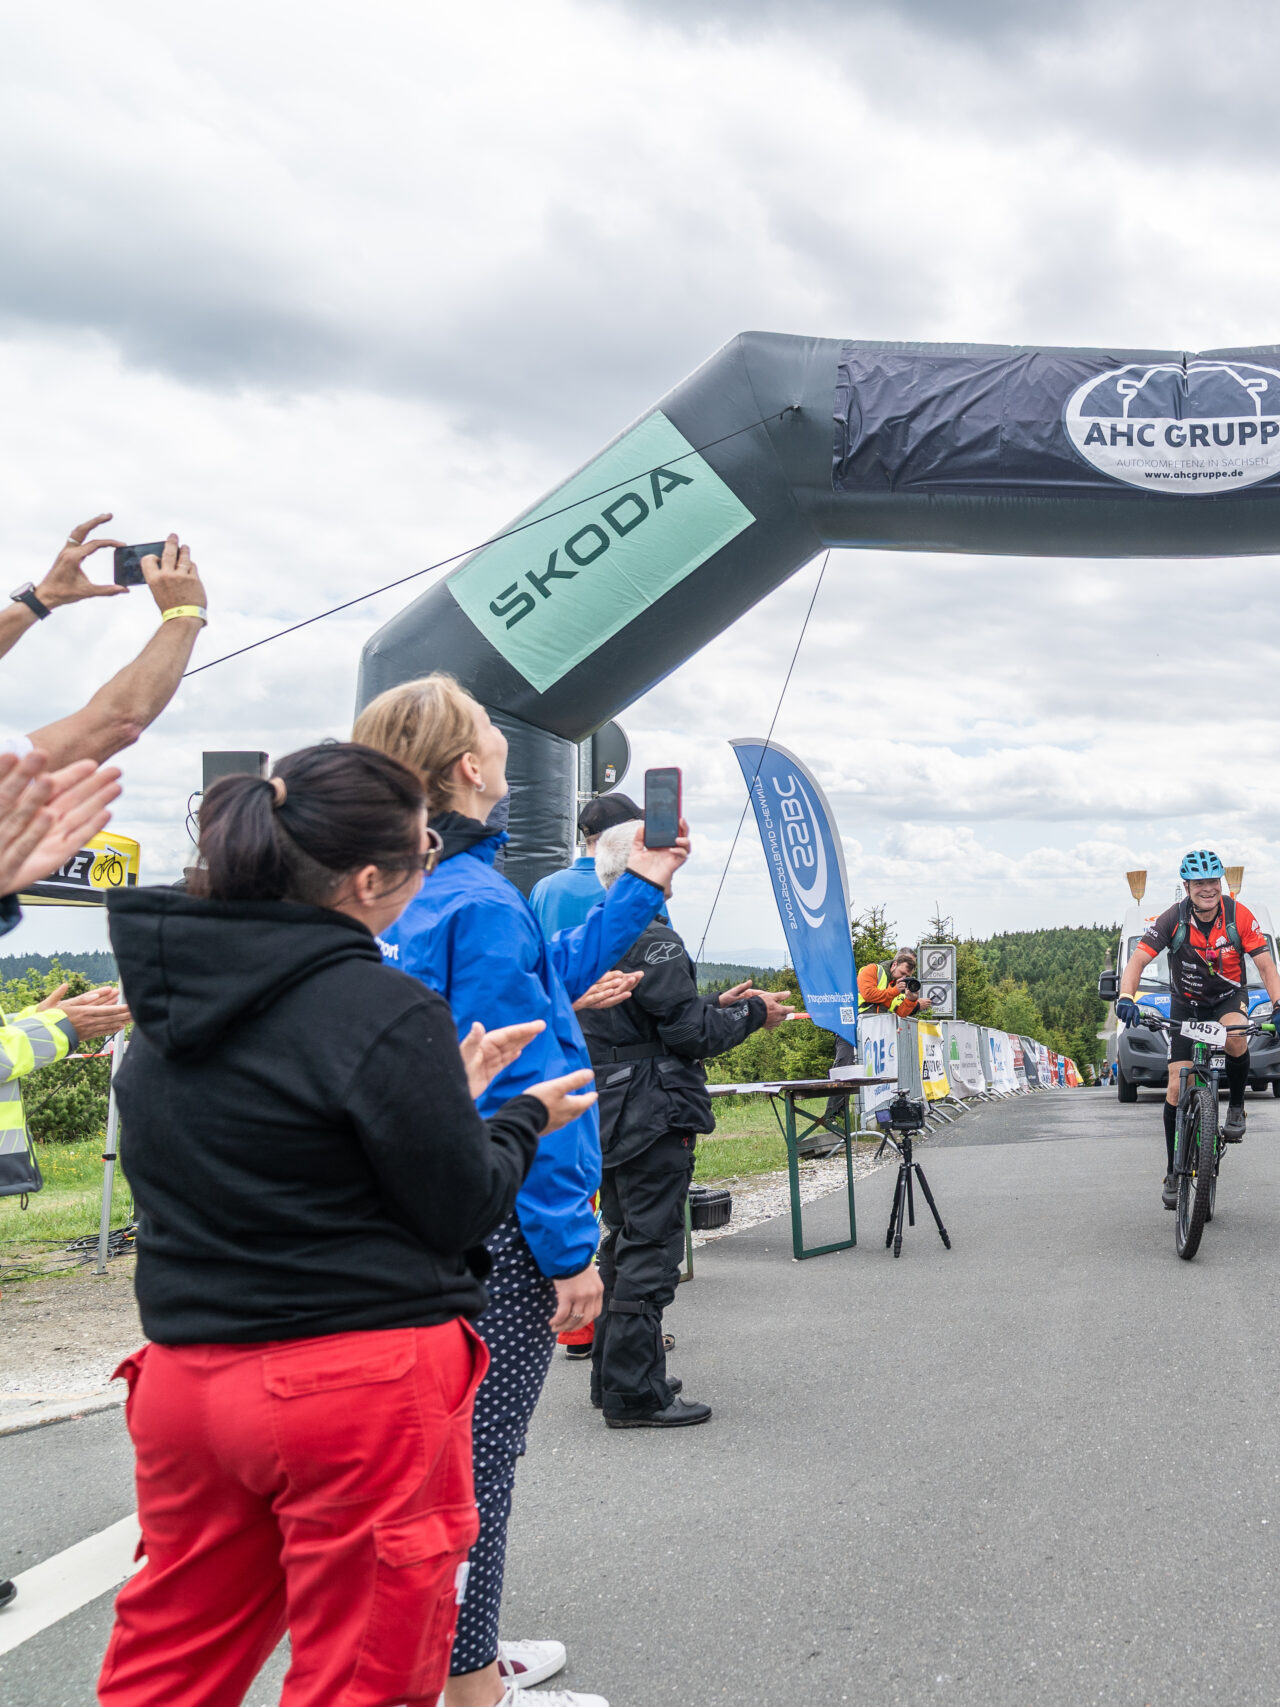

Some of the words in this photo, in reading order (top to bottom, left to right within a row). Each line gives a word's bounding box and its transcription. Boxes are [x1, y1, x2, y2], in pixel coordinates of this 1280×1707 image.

[1083, 422, 1155, 448] AHC
[1116, 457, 1205, 469] AUTOKOMPETENZ
[1207, 459, 1219, 468] IN
[1221, 456, 1269, 467] SACHSEN
[1144, 468, 1244, 481] www.ahcgruppe.de
[489, 467, 695, 631] SKODA
[931, 956, 943, 966] 20
[1189, 1020, 1220, 1036] 0457
[1214, 1058, 1225, 1067] 79
